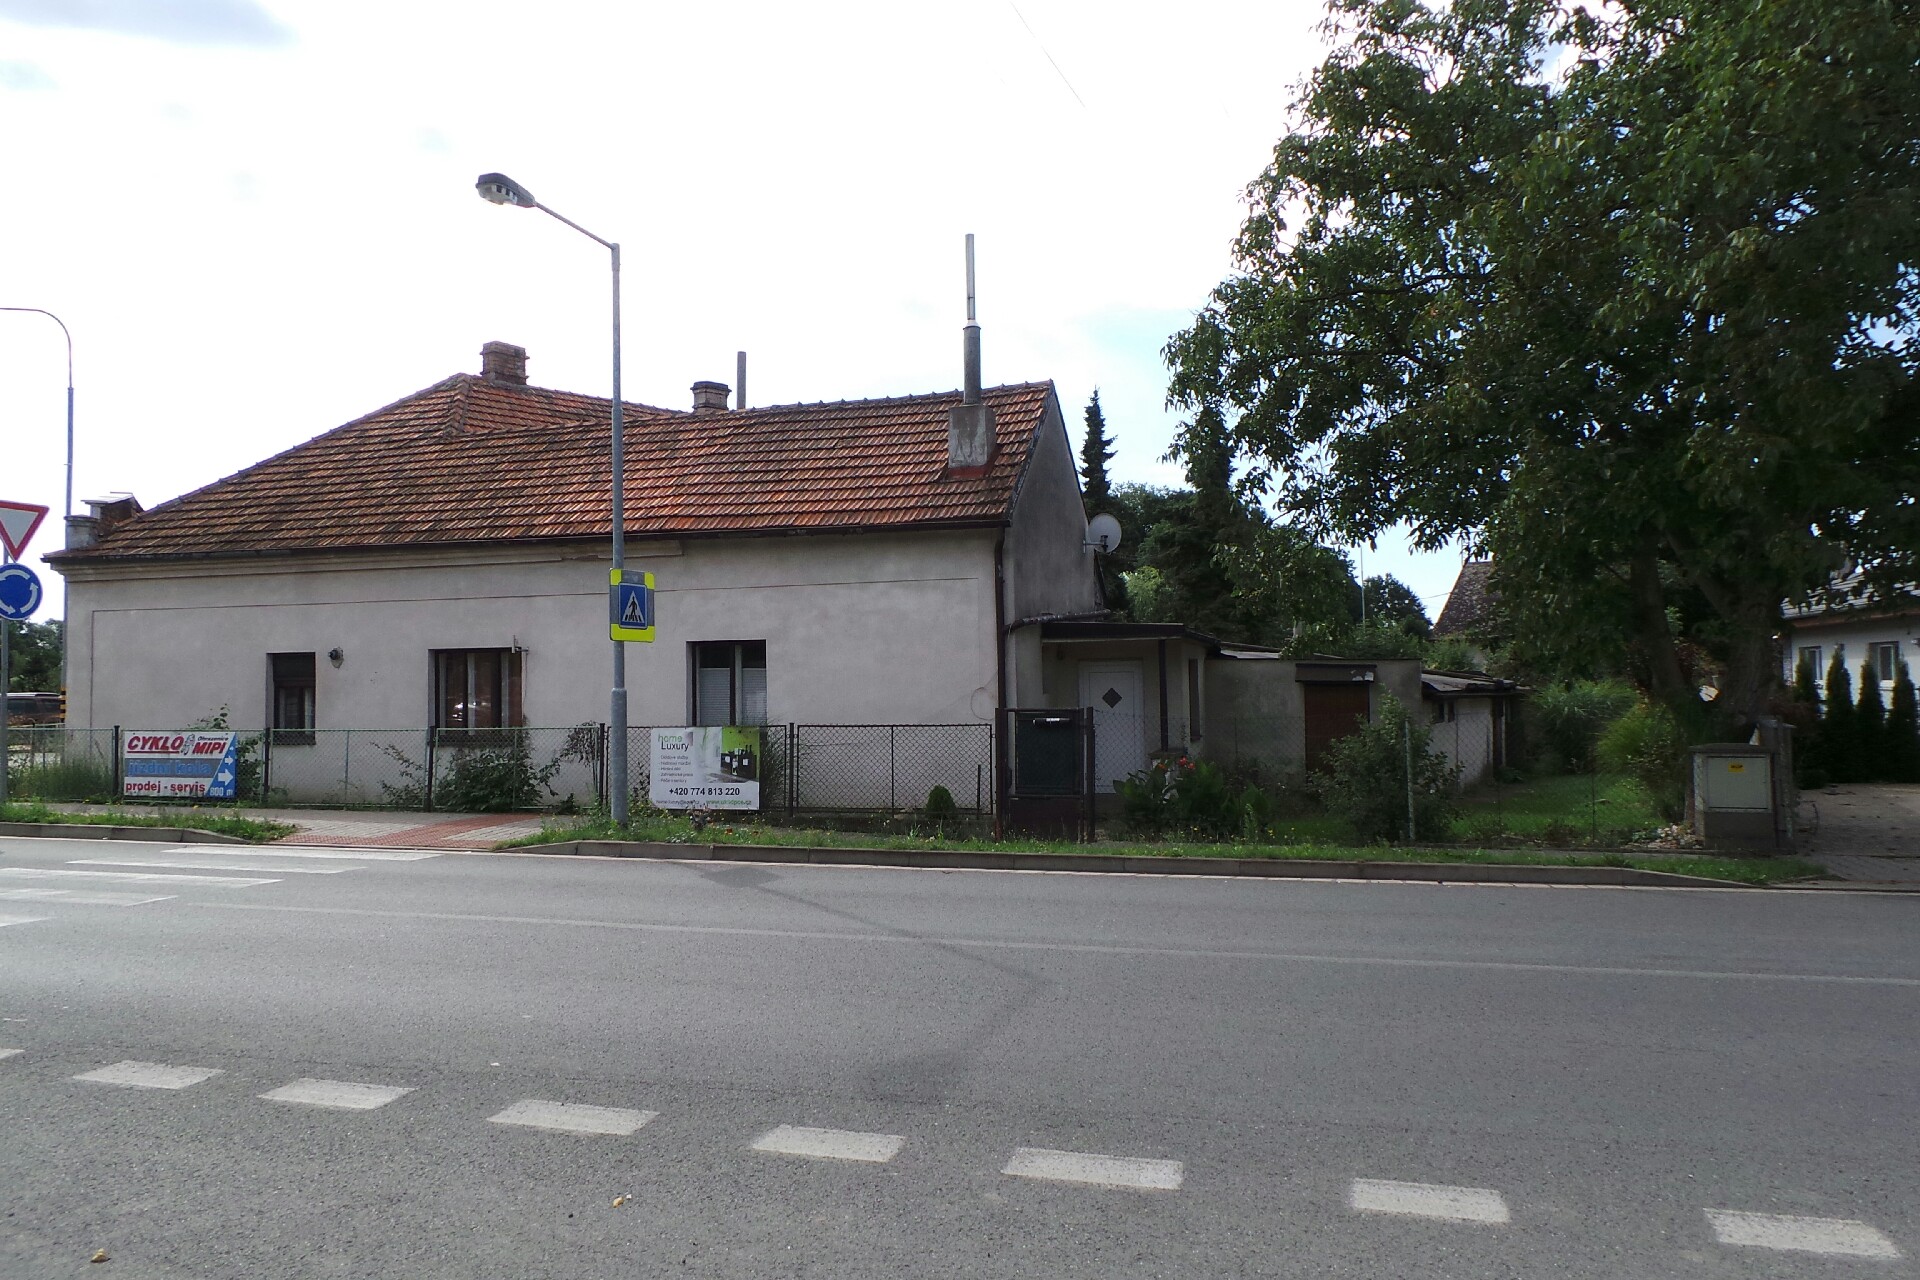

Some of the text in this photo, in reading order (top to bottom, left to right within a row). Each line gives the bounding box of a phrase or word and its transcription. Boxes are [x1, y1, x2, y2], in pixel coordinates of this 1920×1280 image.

[127, 736, 184, 750] CYKLO
[657, 733, 682, 742] home
[192, 741, 227, 754] MIPI
[661, 740, 689, 752] Luxury
[175, 760, 211, 775] kola
[125, 781, 161, 794] prodej
[170, 782, 206, 793] servis
[209, 787, 224, 796] 800
[669, 787, 740, 795] +420 774 813 220
